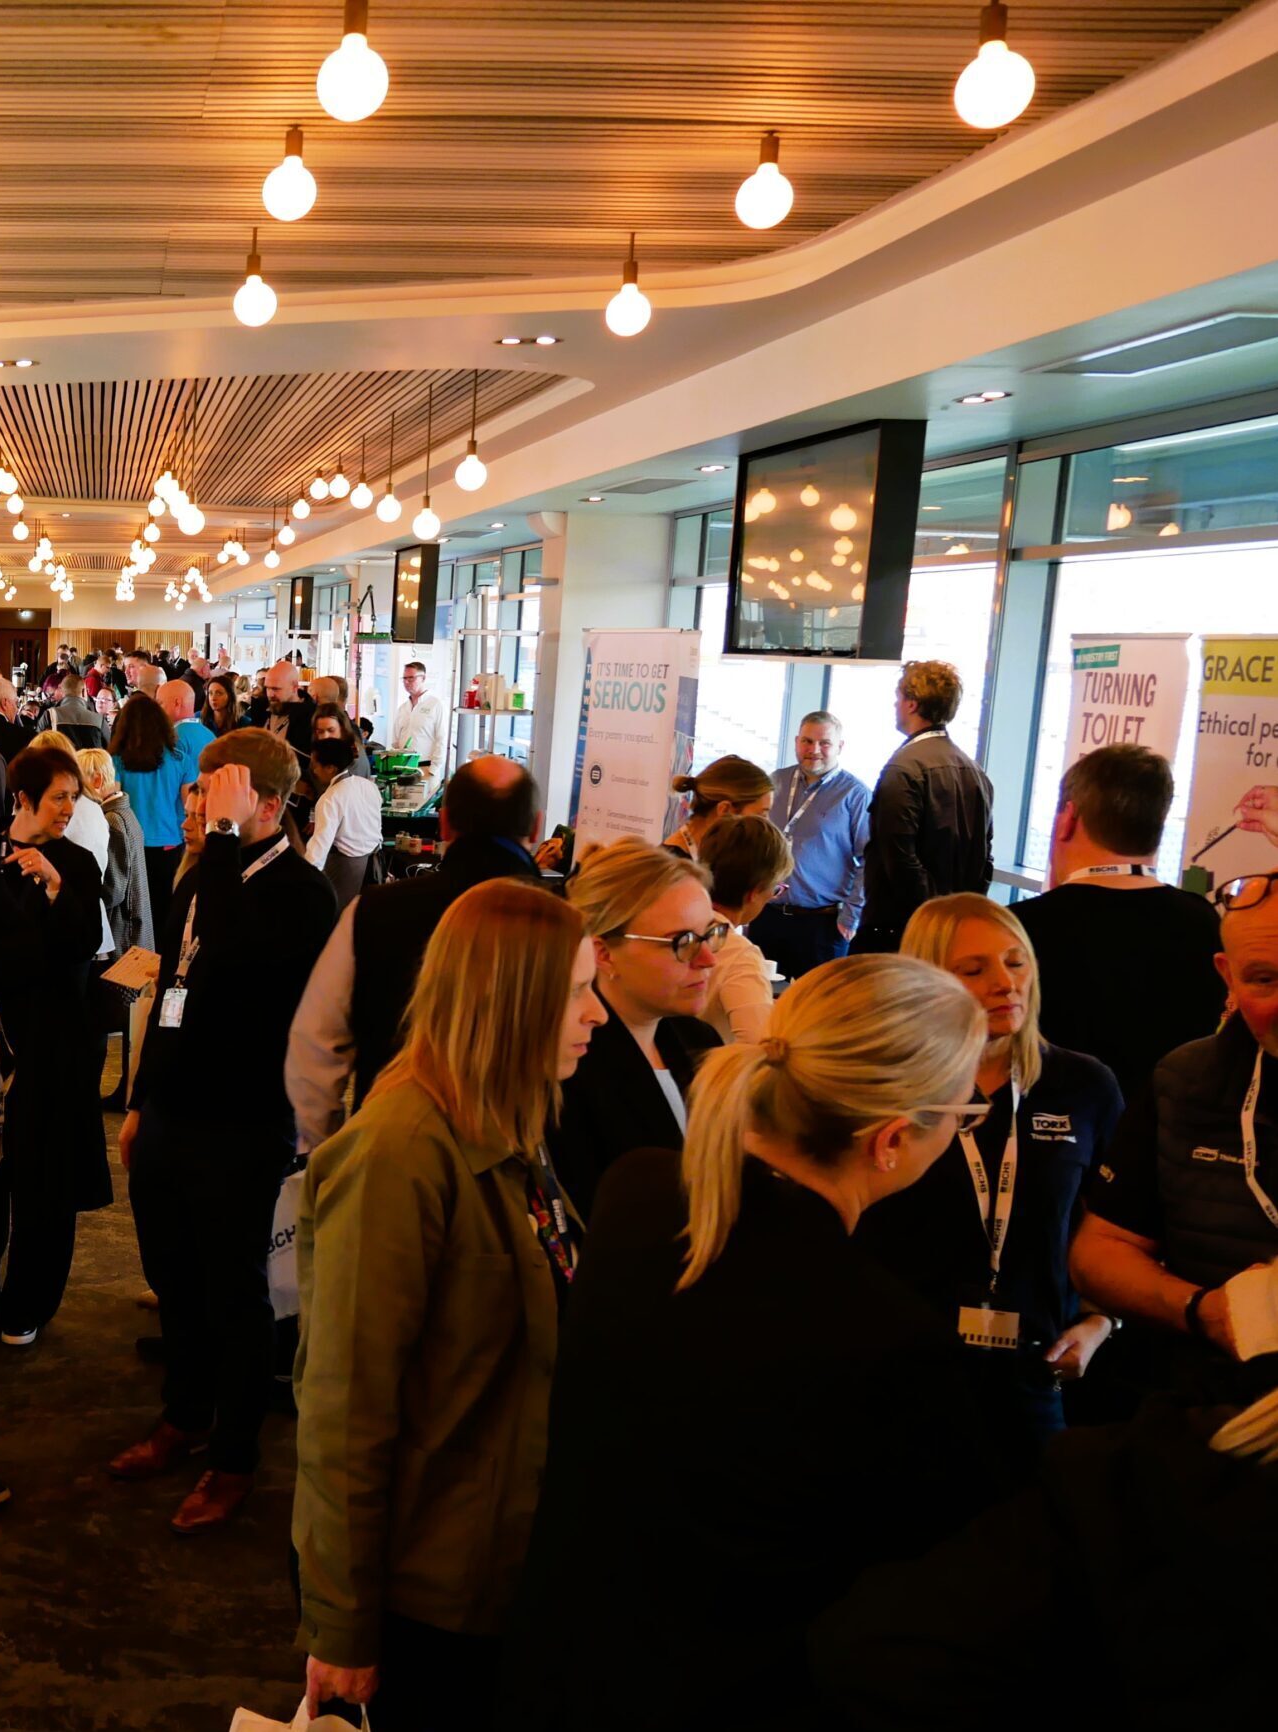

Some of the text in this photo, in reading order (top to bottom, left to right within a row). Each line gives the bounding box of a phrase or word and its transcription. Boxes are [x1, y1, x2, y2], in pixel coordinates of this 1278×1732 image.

[597, 662, 670, 679] IT'S TIME TO GET
[1202, 654, 1275, 683] GRACE
[592, 680, 667, 714] SERIOUS
[1082, 671, 1157, 708] TURNING
[1081, 712, 1146, 746] TOILET
[1198, 711, 1256, 738] Ethical
[1246, 742, 1272, 768] for
[1034, 1118, 1068, 1130] TORK
